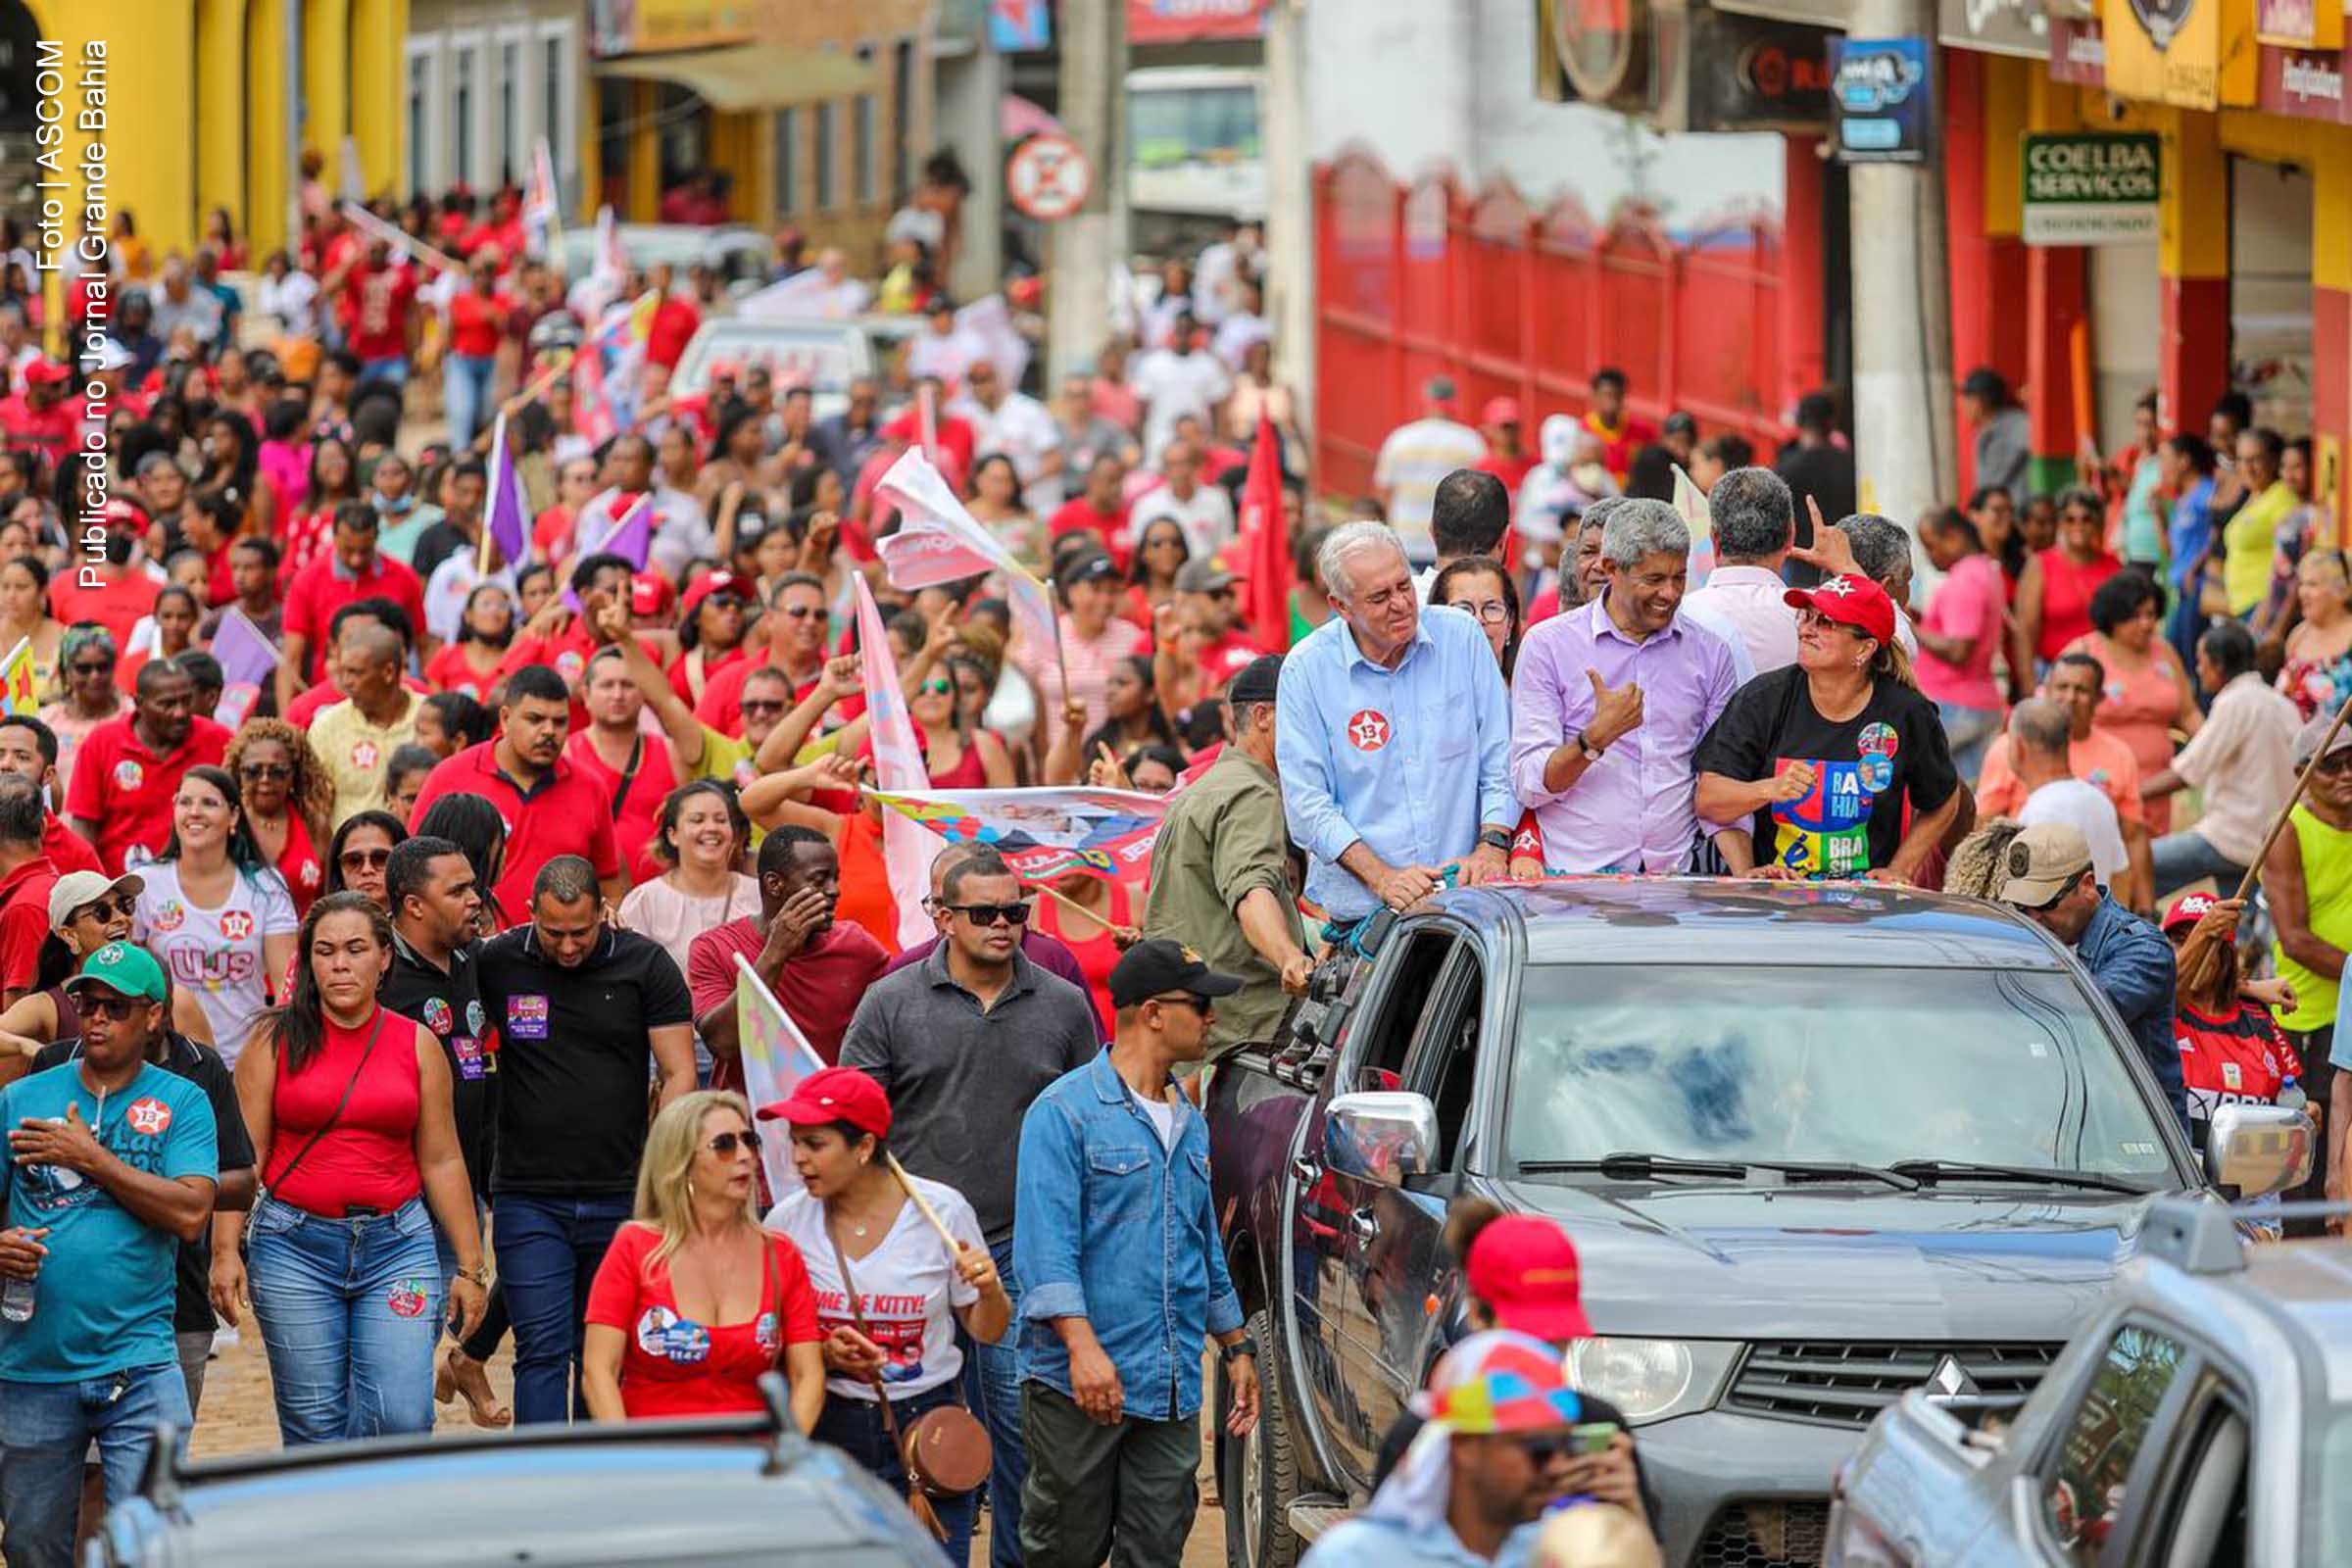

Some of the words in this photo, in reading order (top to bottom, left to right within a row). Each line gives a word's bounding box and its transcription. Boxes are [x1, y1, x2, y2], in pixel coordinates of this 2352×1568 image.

[2030, 143, 2154, 172] COELBA
[1360, 724, 1376, 739] 13
[1833, 771, 1860, 794] BA
[1832, 795, 1859, 818] HIA
[1829, 836, 1862, 858] BRA
[171, 947, 255, 984] UJS
[140, 1109, 156, 1123] 13
